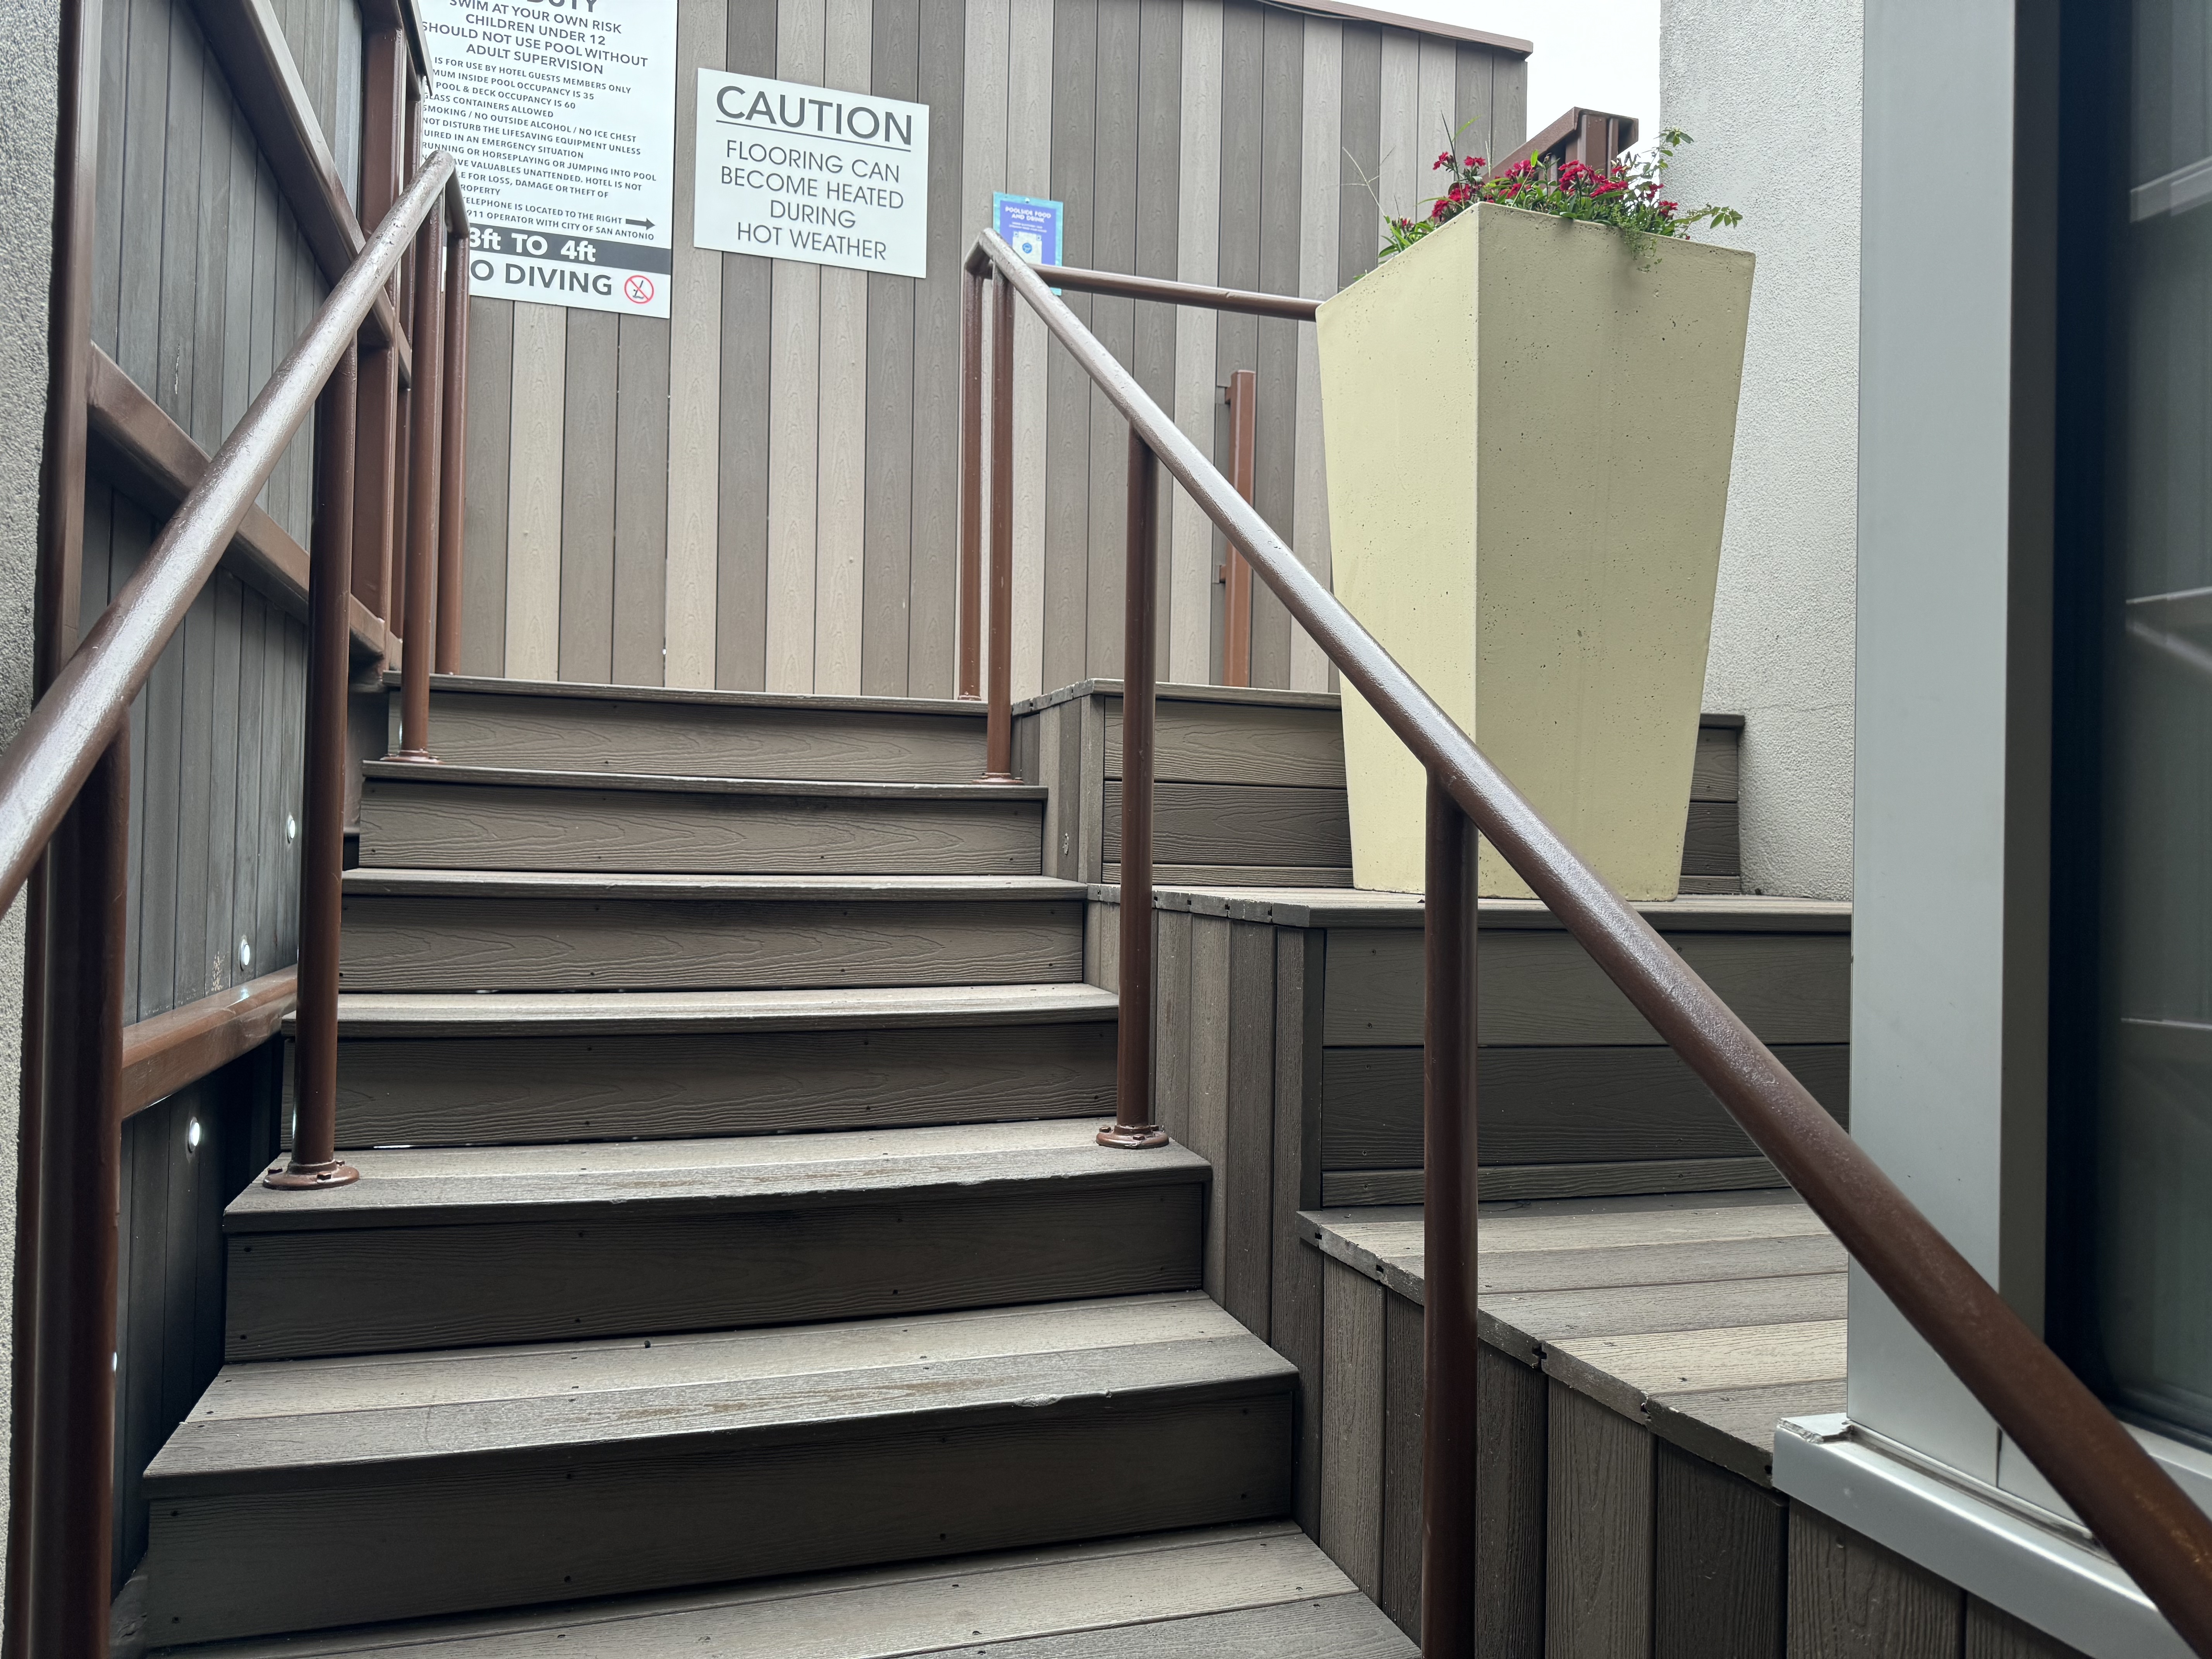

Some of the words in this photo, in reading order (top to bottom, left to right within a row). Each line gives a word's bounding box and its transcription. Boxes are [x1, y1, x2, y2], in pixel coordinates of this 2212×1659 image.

[450, 0, 488, 11] SWIM
[492, 3, 509, 14] AT
[512, 6, 550, 21] YOUR
[554, 14, 587, 27] OWN
[593, 20, 622, 34] RISK
[466, 14, 534, 33] CHILDREN
[539, 26, 585, 42] UNDER
[590, 35, 605, 45] 12
[422, 22, 478, 38] SHOULD
[483, 31, 512, 44] NOT
[516, 36, 540, 49] USE
[545, 41, 582, 56] POOL
[585, 48, 648, 67] WITHOUT
[466, 44, 510, 58] ADULT
[514, 51, 603, 74] SUPERVISION
[433, 69, 455, 78] MUM
[459, 73, 488, 83] INSIDE
[491, 78, 515, 87] POOL
[517, 82, 570, 96] OCCUPANCY
[446, 59, 463, 67] FOR
[466, 62, 482, 70] USE
[500, 67, 526, 77] HOTEL
[529, 72, 560, 82] GUESTS
[563, 77, 606, 89] MEMBERS
[609, 85, 631, 93] ONLY
[436, 82, 460, 91] POOL
[473, 88, 495, 96] DECK
[498, 91, 551, 105] OCCUPANCY
[453, 97, 509, 111] CONTAINERS
[512, 106, 553, 117] ALLOWED
[423, 105, 465, 117] SMOKING
[491, 115, 528, 126] OUTSIDE
[531, 121, 571, 132] ALCOHOL
[610, 133, 636, 142] CHEST
[717, 86, 912, 146] CAUTION
[424, 130, 451, 139] UIRED
[483, 138, 536, 151] EMERGENCY
[538, 146, 583, 158] SITUATION
[443, 120, 481, 131] DISTURB
[483, 126, 499, 134] THE
[503, 129, 552, 141] LIFESAVING
[556, 137, 606, 150] EQUIPMENT
[610, 144, 640, 155] UNLESS
[422, 142, 464, 153] RUNNING
[483, 150, 550, 165] HORSEPLAYING
[567, 163, 608, 174] JUMPING
[611, 169, 630, 177] INTO
[634, 172, 656, 181] POOL
[471, 161, 520, 173] VALUABLES
[524, 168, 582, 182] UNATTENDED.
[586, 177, 612, 186] HOTEL
[727, 139, 843, 173] FLOORING
[852, 160, 899, 183] CAN
[461, 184, 500, 195] ROPERTY
[489, 175, 512, 185] LOSS,
[516, 180, 553, 190] DAMAGE
[570, 187, 595, 196] THEFT
[721, 166, 817, 197] BECOME
[827, 181, 903, 209] HEATED
[463, 197, 512, 209] ELEPHONE
[526, 205, 563, 215] LOCATED
[597, 215, 622, 224] RIGHT
[487, 213, 533, 224] OPERATOR
[536, 219, 558, 227] WITH
[615, 230, 654, 240] ANTONIO
[771, 200, 855, 228] DURING
[469, 227, 501, 250] 3ft
[511, 233, 548, 255] TO
[561, 240, 596, 262] 4ft
[738, 222, 782, 246] HOT
[790, 229, 886, 260] WEATHER
[471, 259, 494, 281] O
[505, 263, 611, 295] DIVING
